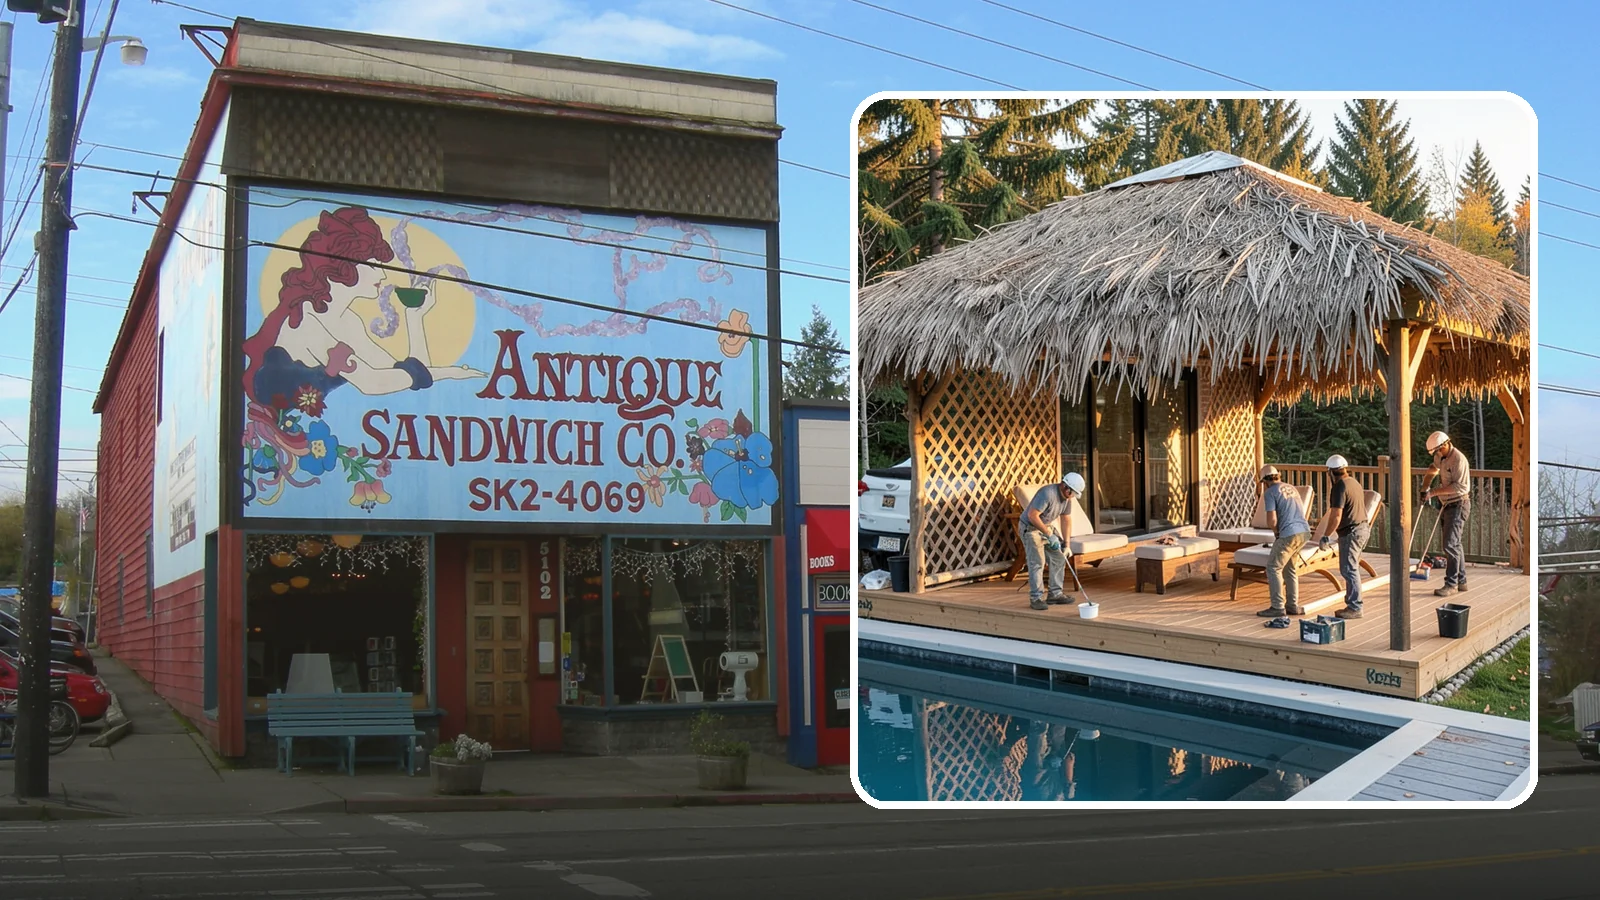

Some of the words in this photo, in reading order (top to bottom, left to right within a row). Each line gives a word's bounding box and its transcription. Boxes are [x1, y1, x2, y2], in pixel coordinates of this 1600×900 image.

[476, 330, 723, 420] ANTIQUE
[361, 409, 604, 467] SANDWICH
[617, 421, 684, 469] CO.
[468, 477, 645, 513] SK2-4069
[540, 542, 551, 599] 5102
[809, 555, 834, 568] BOOKS
